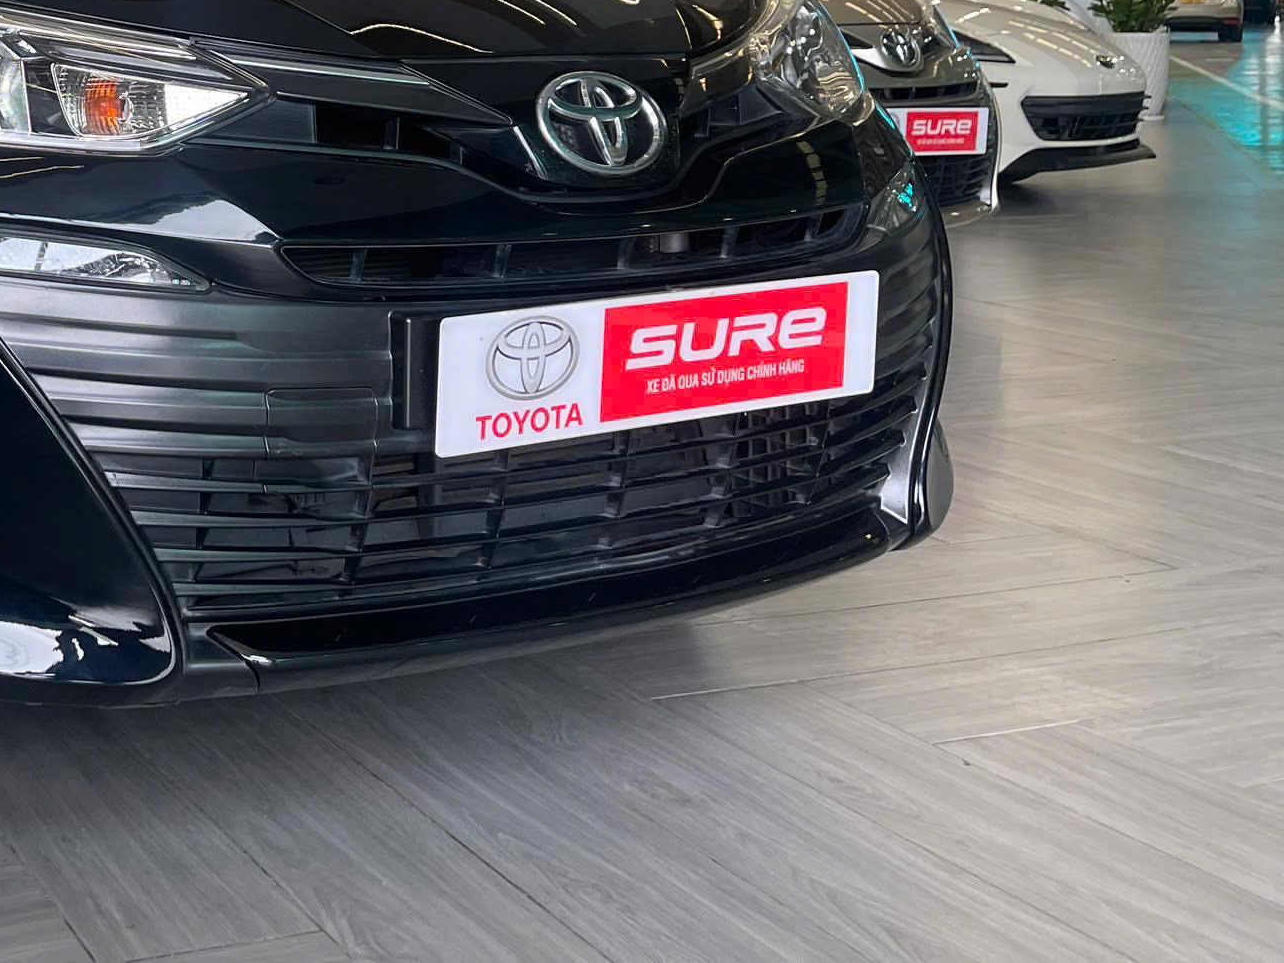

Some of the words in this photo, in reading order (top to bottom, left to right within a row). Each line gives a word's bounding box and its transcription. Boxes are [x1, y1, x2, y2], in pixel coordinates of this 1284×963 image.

[646, 379, 660, 394] XE
[661, 374, 677, 391] ĐÃ
[677, 373, 699, 390] QUA
[701, 366, 716, 387] SỬ
[717, 368, 745, 387] DỤNG
[747, 360, 777, 380] CHÍNH
[475, 402, 584, 442] TOYOTA
